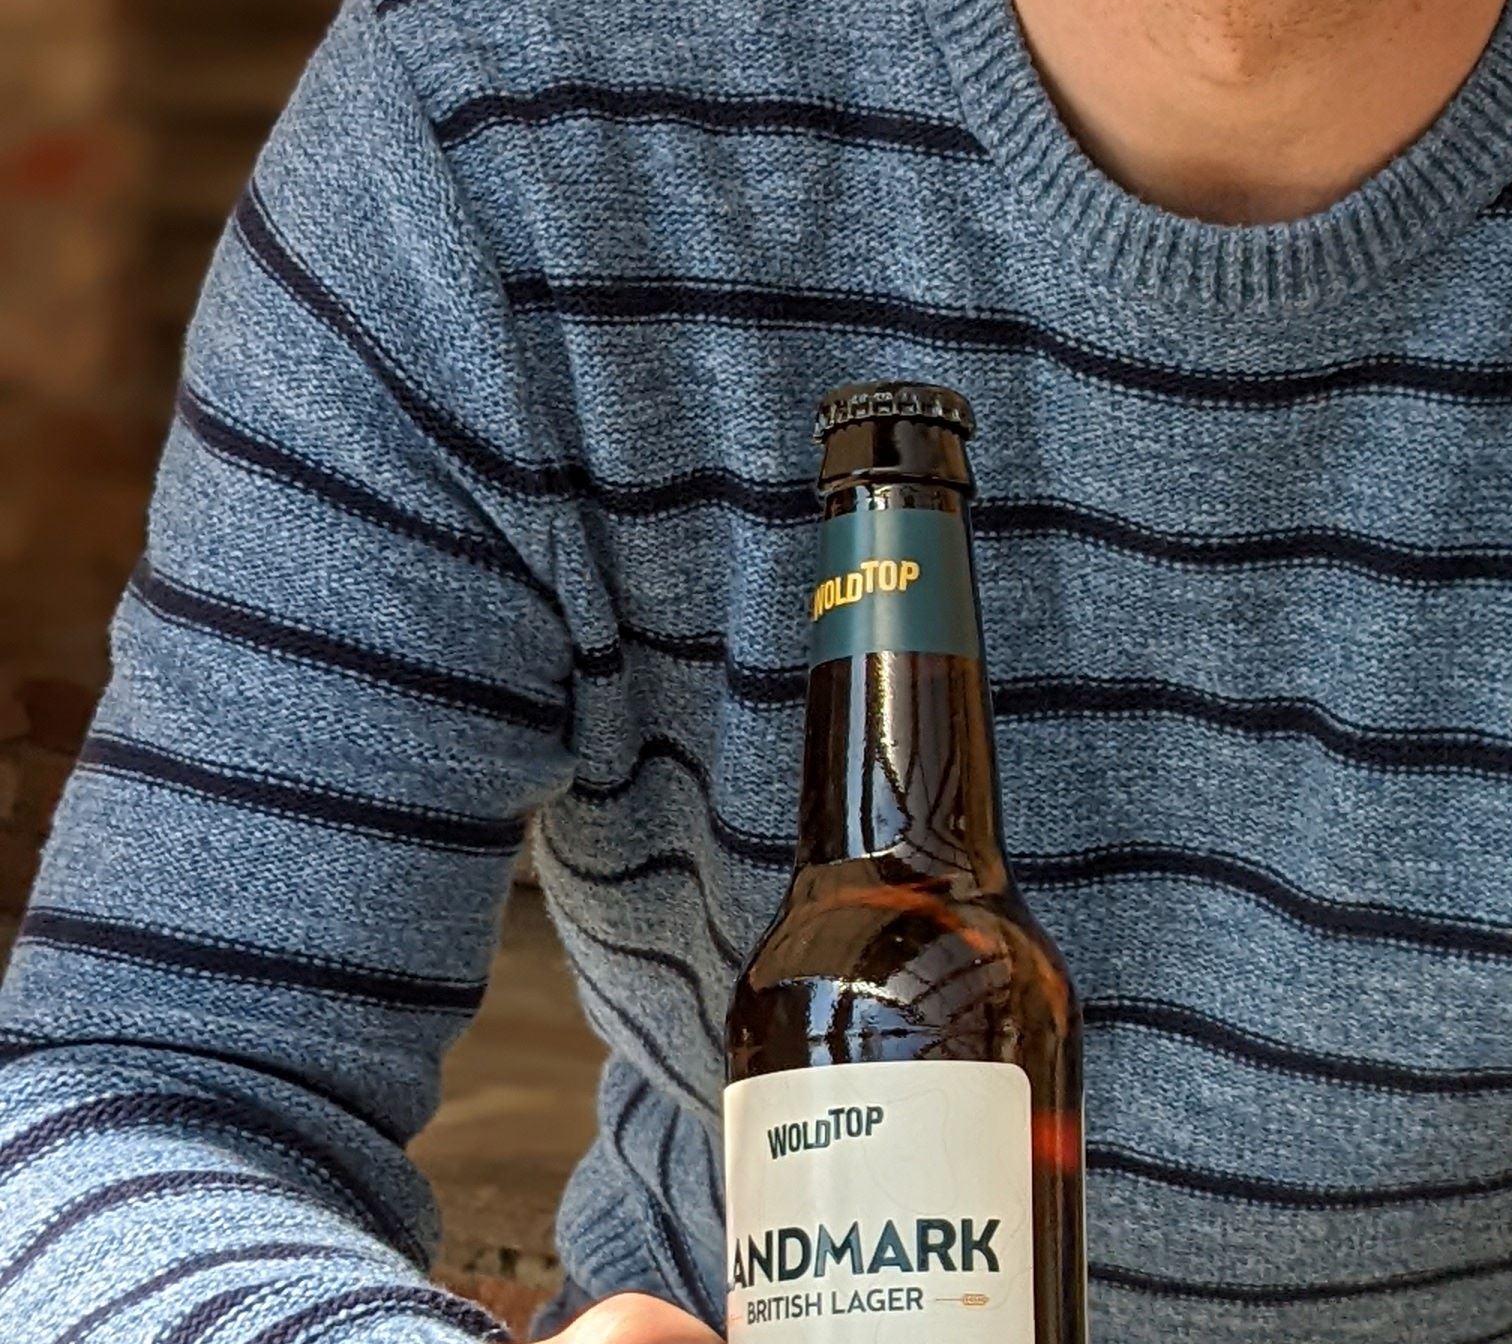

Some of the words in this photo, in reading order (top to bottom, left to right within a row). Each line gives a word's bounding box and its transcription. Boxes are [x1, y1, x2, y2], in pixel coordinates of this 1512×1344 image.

[728, 1217, 1002, 1293] ANDMARK
[746, 1291, 823, 1326] BRITISH
[831, 1286, 924, 1316] LAGER
